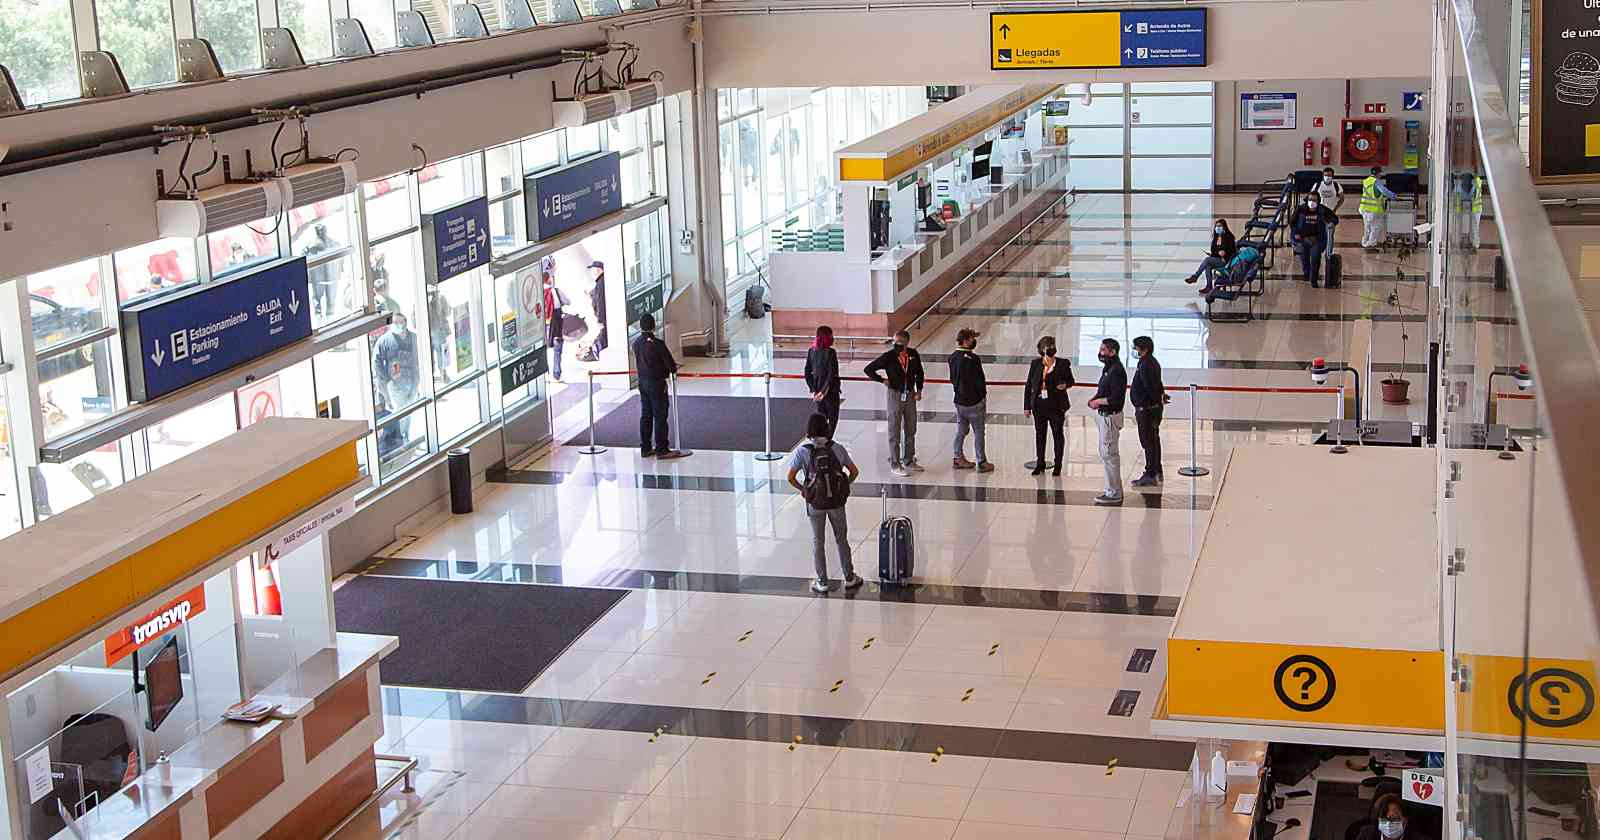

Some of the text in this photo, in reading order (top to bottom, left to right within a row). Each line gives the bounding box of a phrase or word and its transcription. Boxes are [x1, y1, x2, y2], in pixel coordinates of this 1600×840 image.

[1561, 28, 1576, 38] de
[1016, 48, 1060, 58] Llegadas
[256, 298, 282, 316] SALIDA
[190, 312, 248, 341] Estacionamiento
[269, 312, 282, 324] Exit
[191, 336, 219, 354] Parking
[296, 520, 318, 538] OFICIALES
[133, 600, 190, 644] transvip
[1411, 774, 1434, 783] DEA
